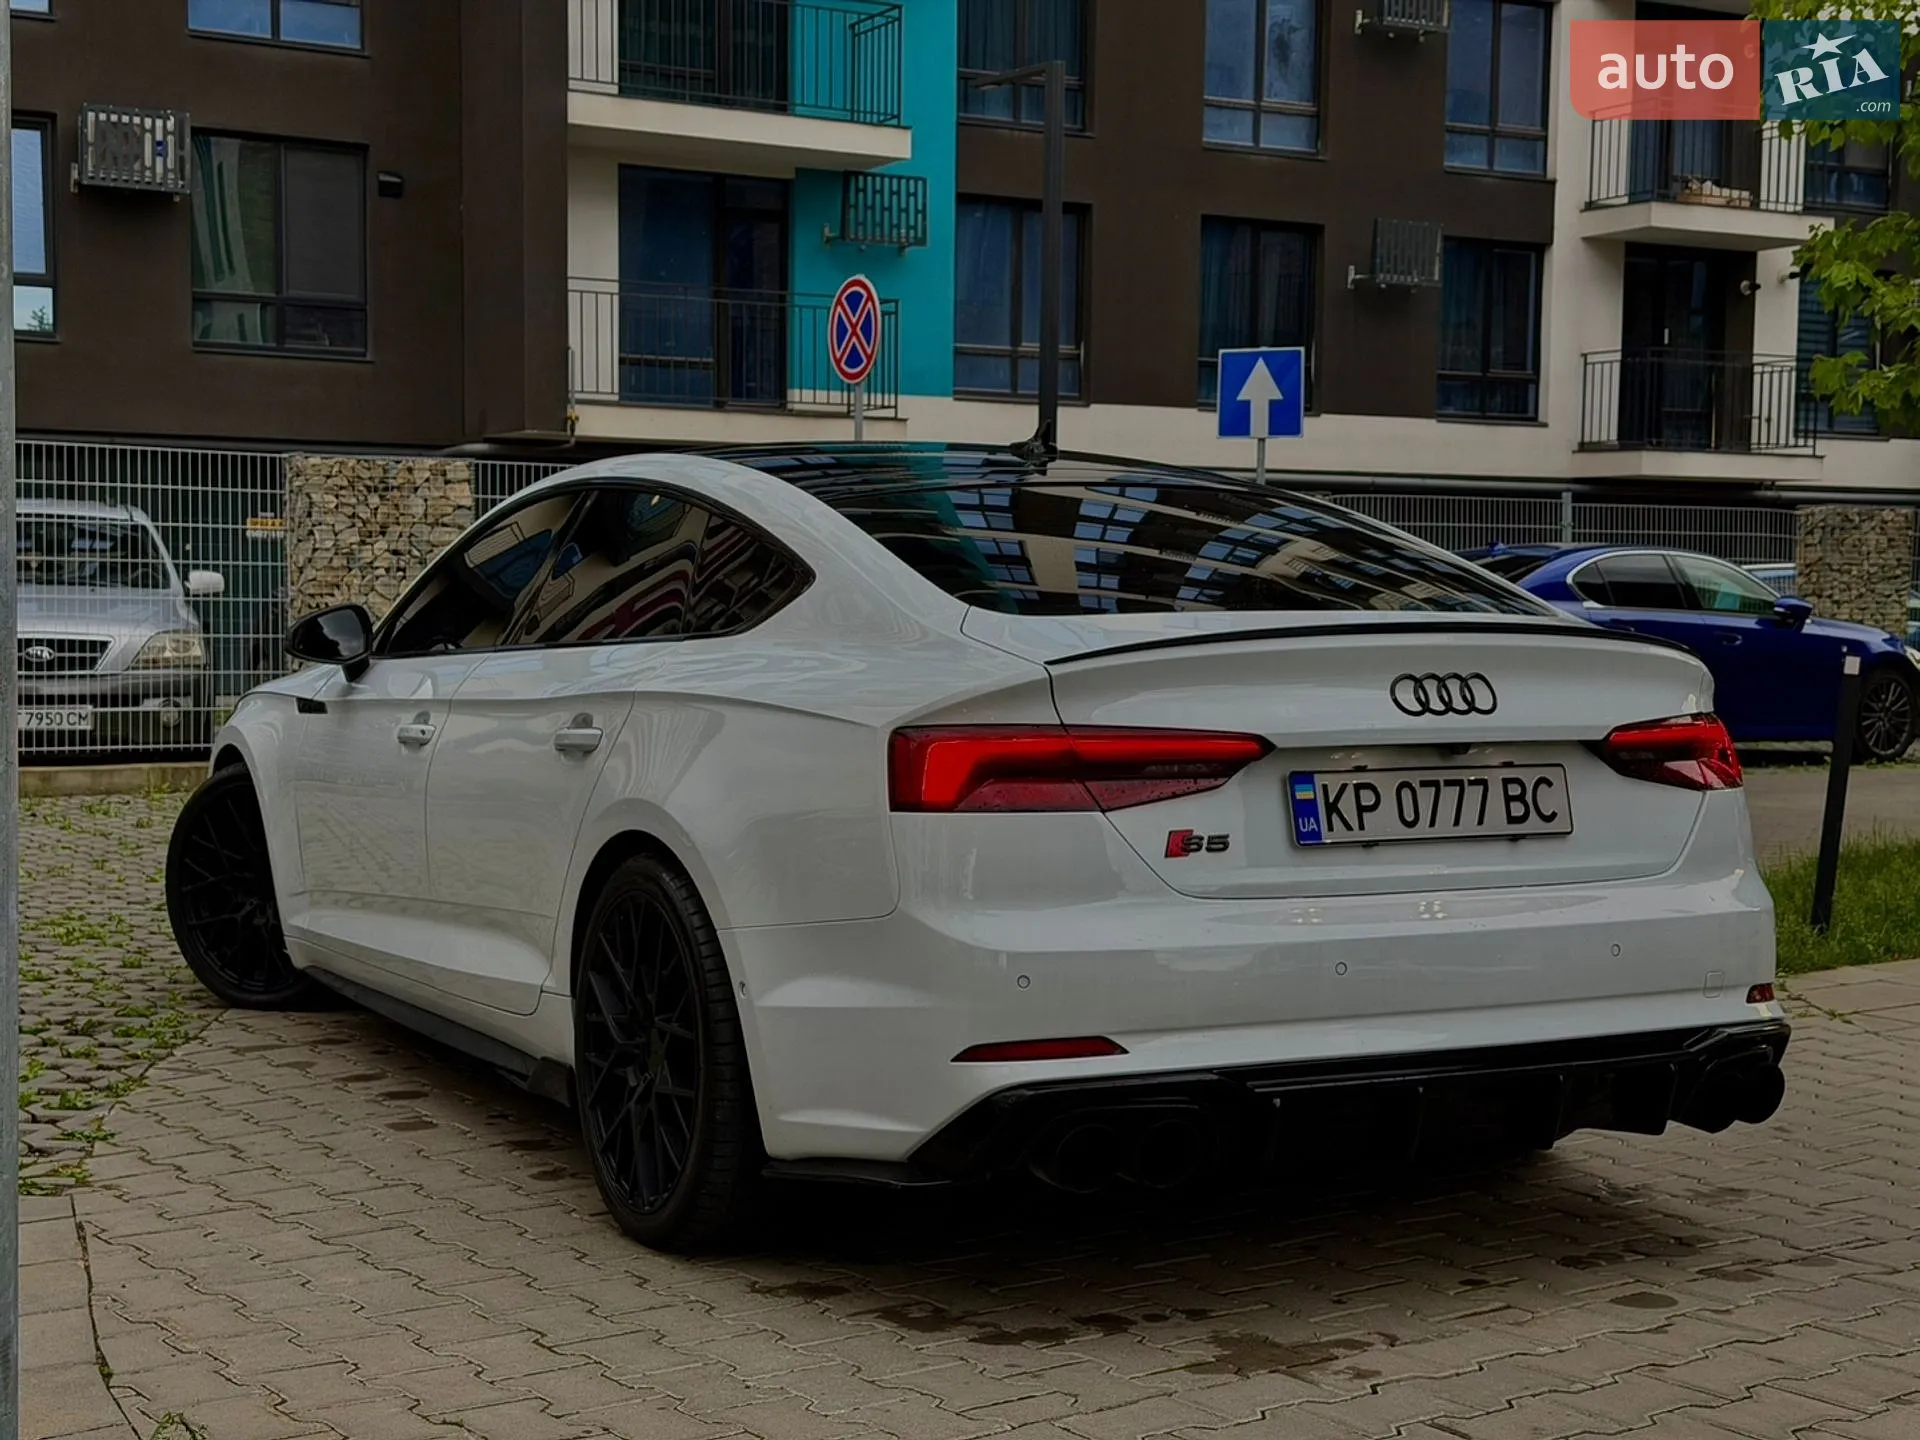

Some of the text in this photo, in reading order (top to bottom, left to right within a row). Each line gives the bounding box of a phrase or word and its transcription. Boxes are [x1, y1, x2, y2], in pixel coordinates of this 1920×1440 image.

[25, 711, 63, 726] 7950
[1321, 775, 1559, 832] KP 0777 BC
[1298, 817, 1319, 832] UA
[1180, 833, 1231, 854] S5
